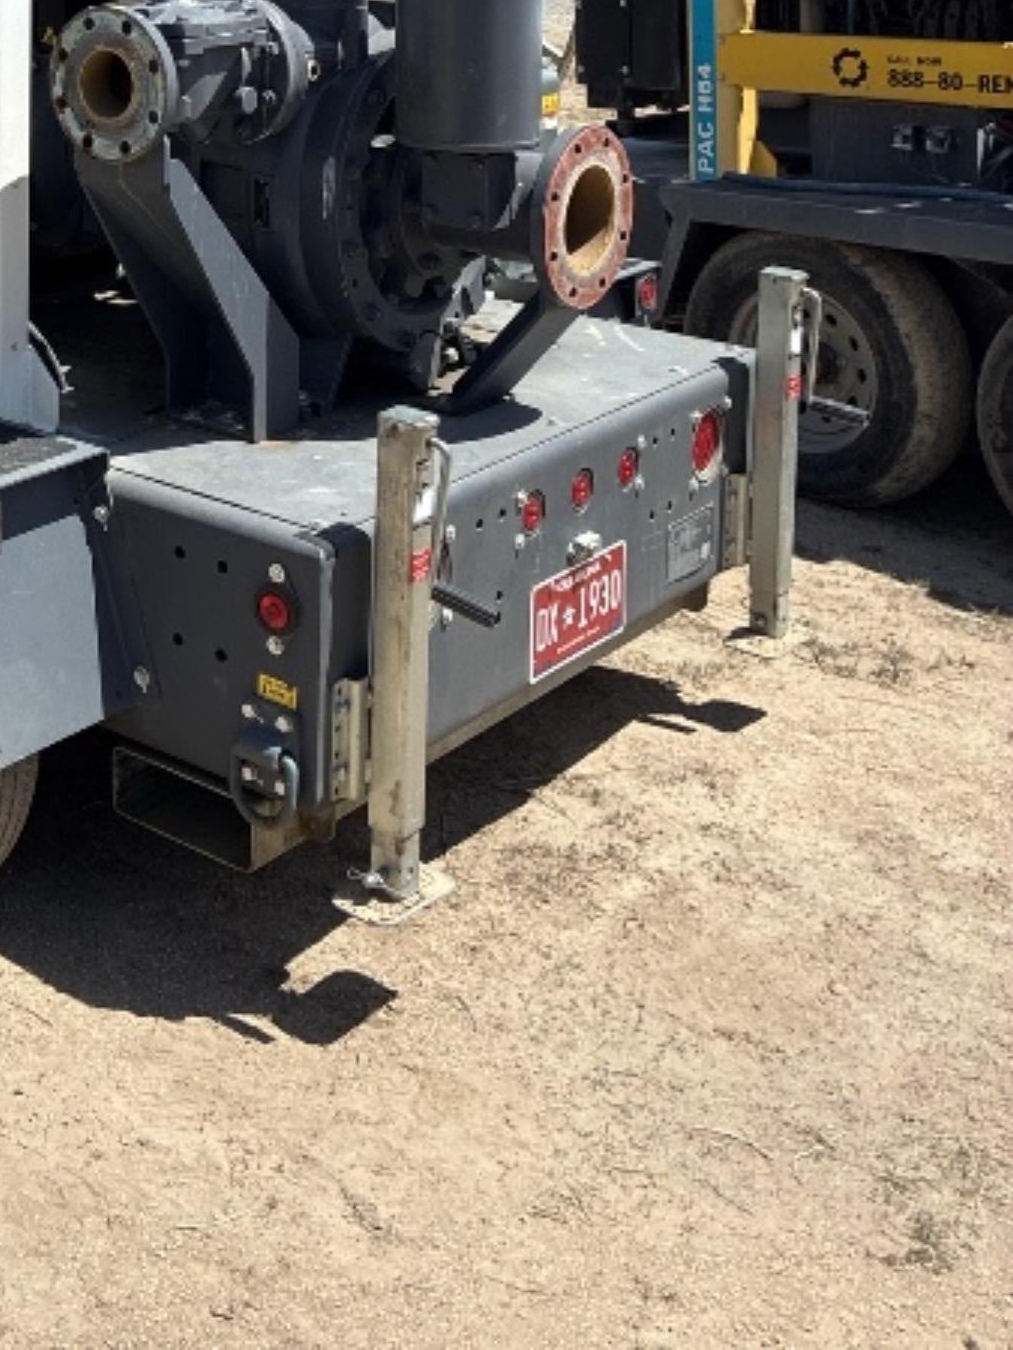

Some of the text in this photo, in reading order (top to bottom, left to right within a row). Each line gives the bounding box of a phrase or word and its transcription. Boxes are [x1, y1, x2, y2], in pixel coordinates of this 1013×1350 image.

[887, 68, 1013, 94] 888-80-REN
[698, 122, 714, 173] PAC
[578, 569, 621, 629] 1930
